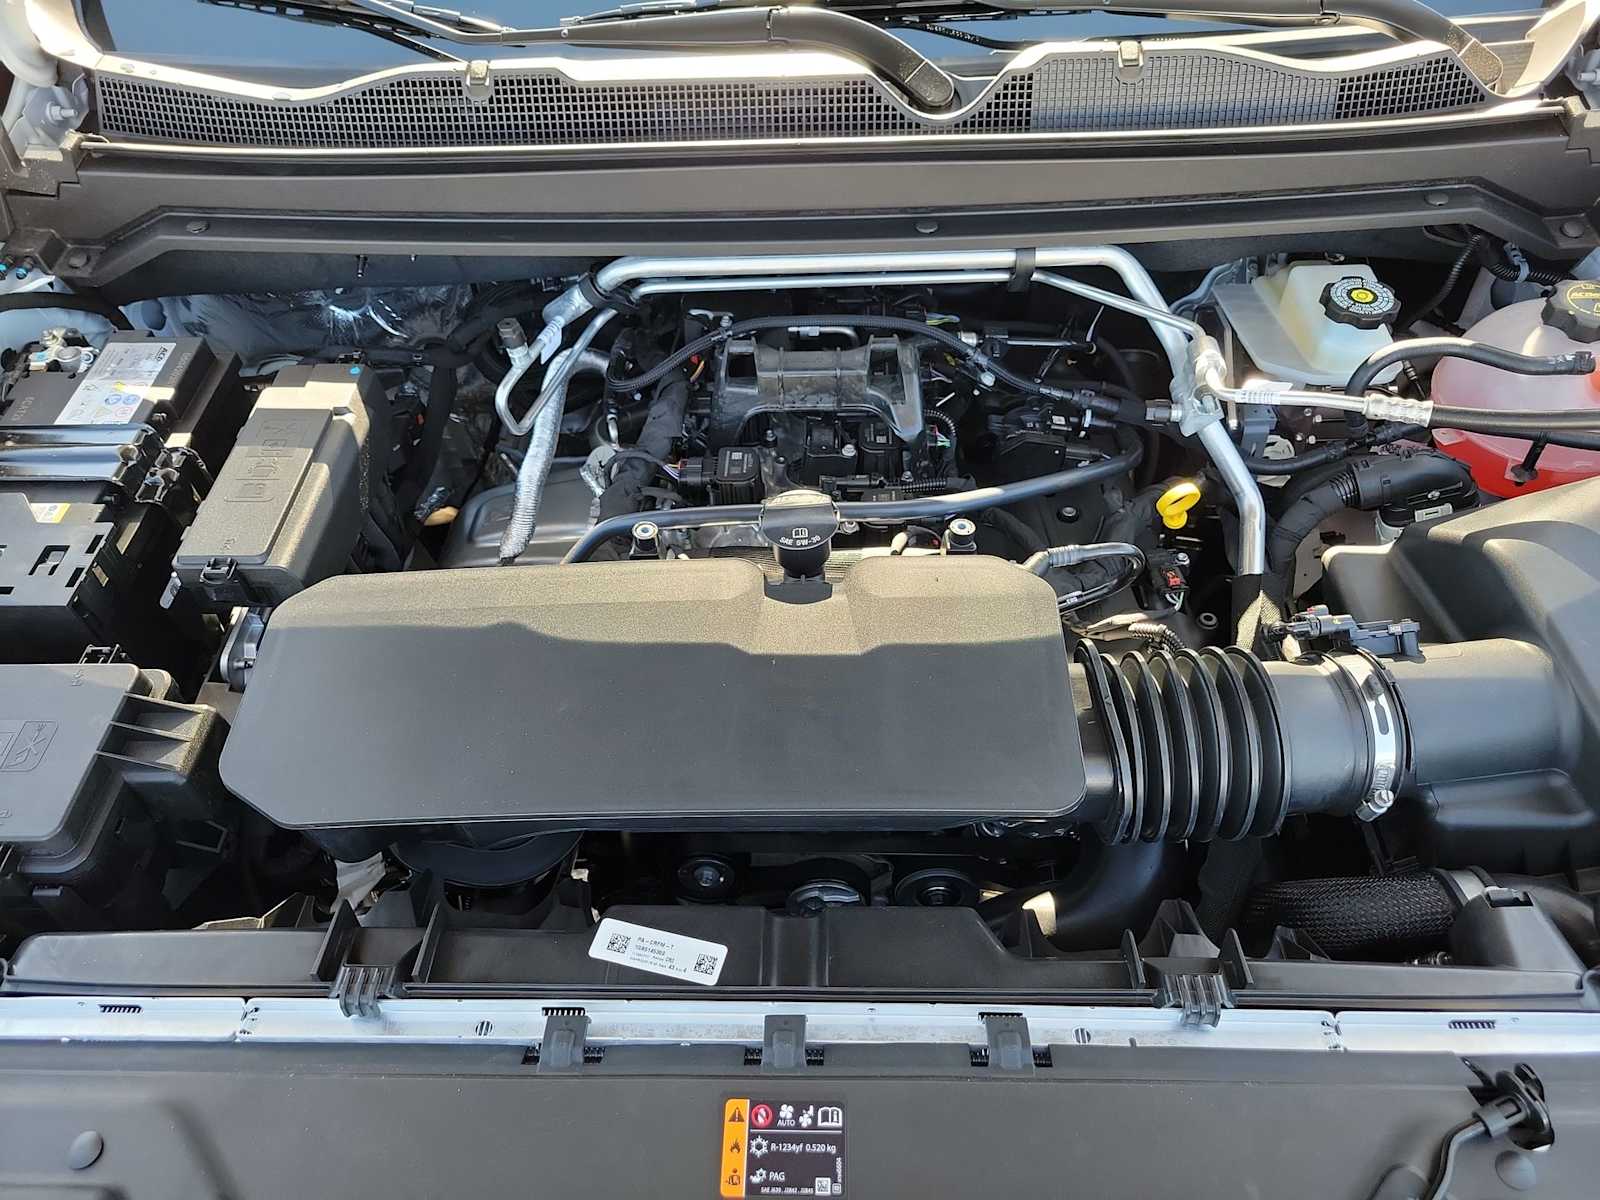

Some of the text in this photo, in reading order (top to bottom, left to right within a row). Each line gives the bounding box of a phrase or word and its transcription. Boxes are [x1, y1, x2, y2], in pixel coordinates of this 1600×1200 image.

[780, 536, 793, 545] SAE
[777, 1119, 796, 1127] AUTO
[771, 1143, 837, 1154] R-1234yf 0.520 kg
[769, 1171, 786, 1181] PAG
